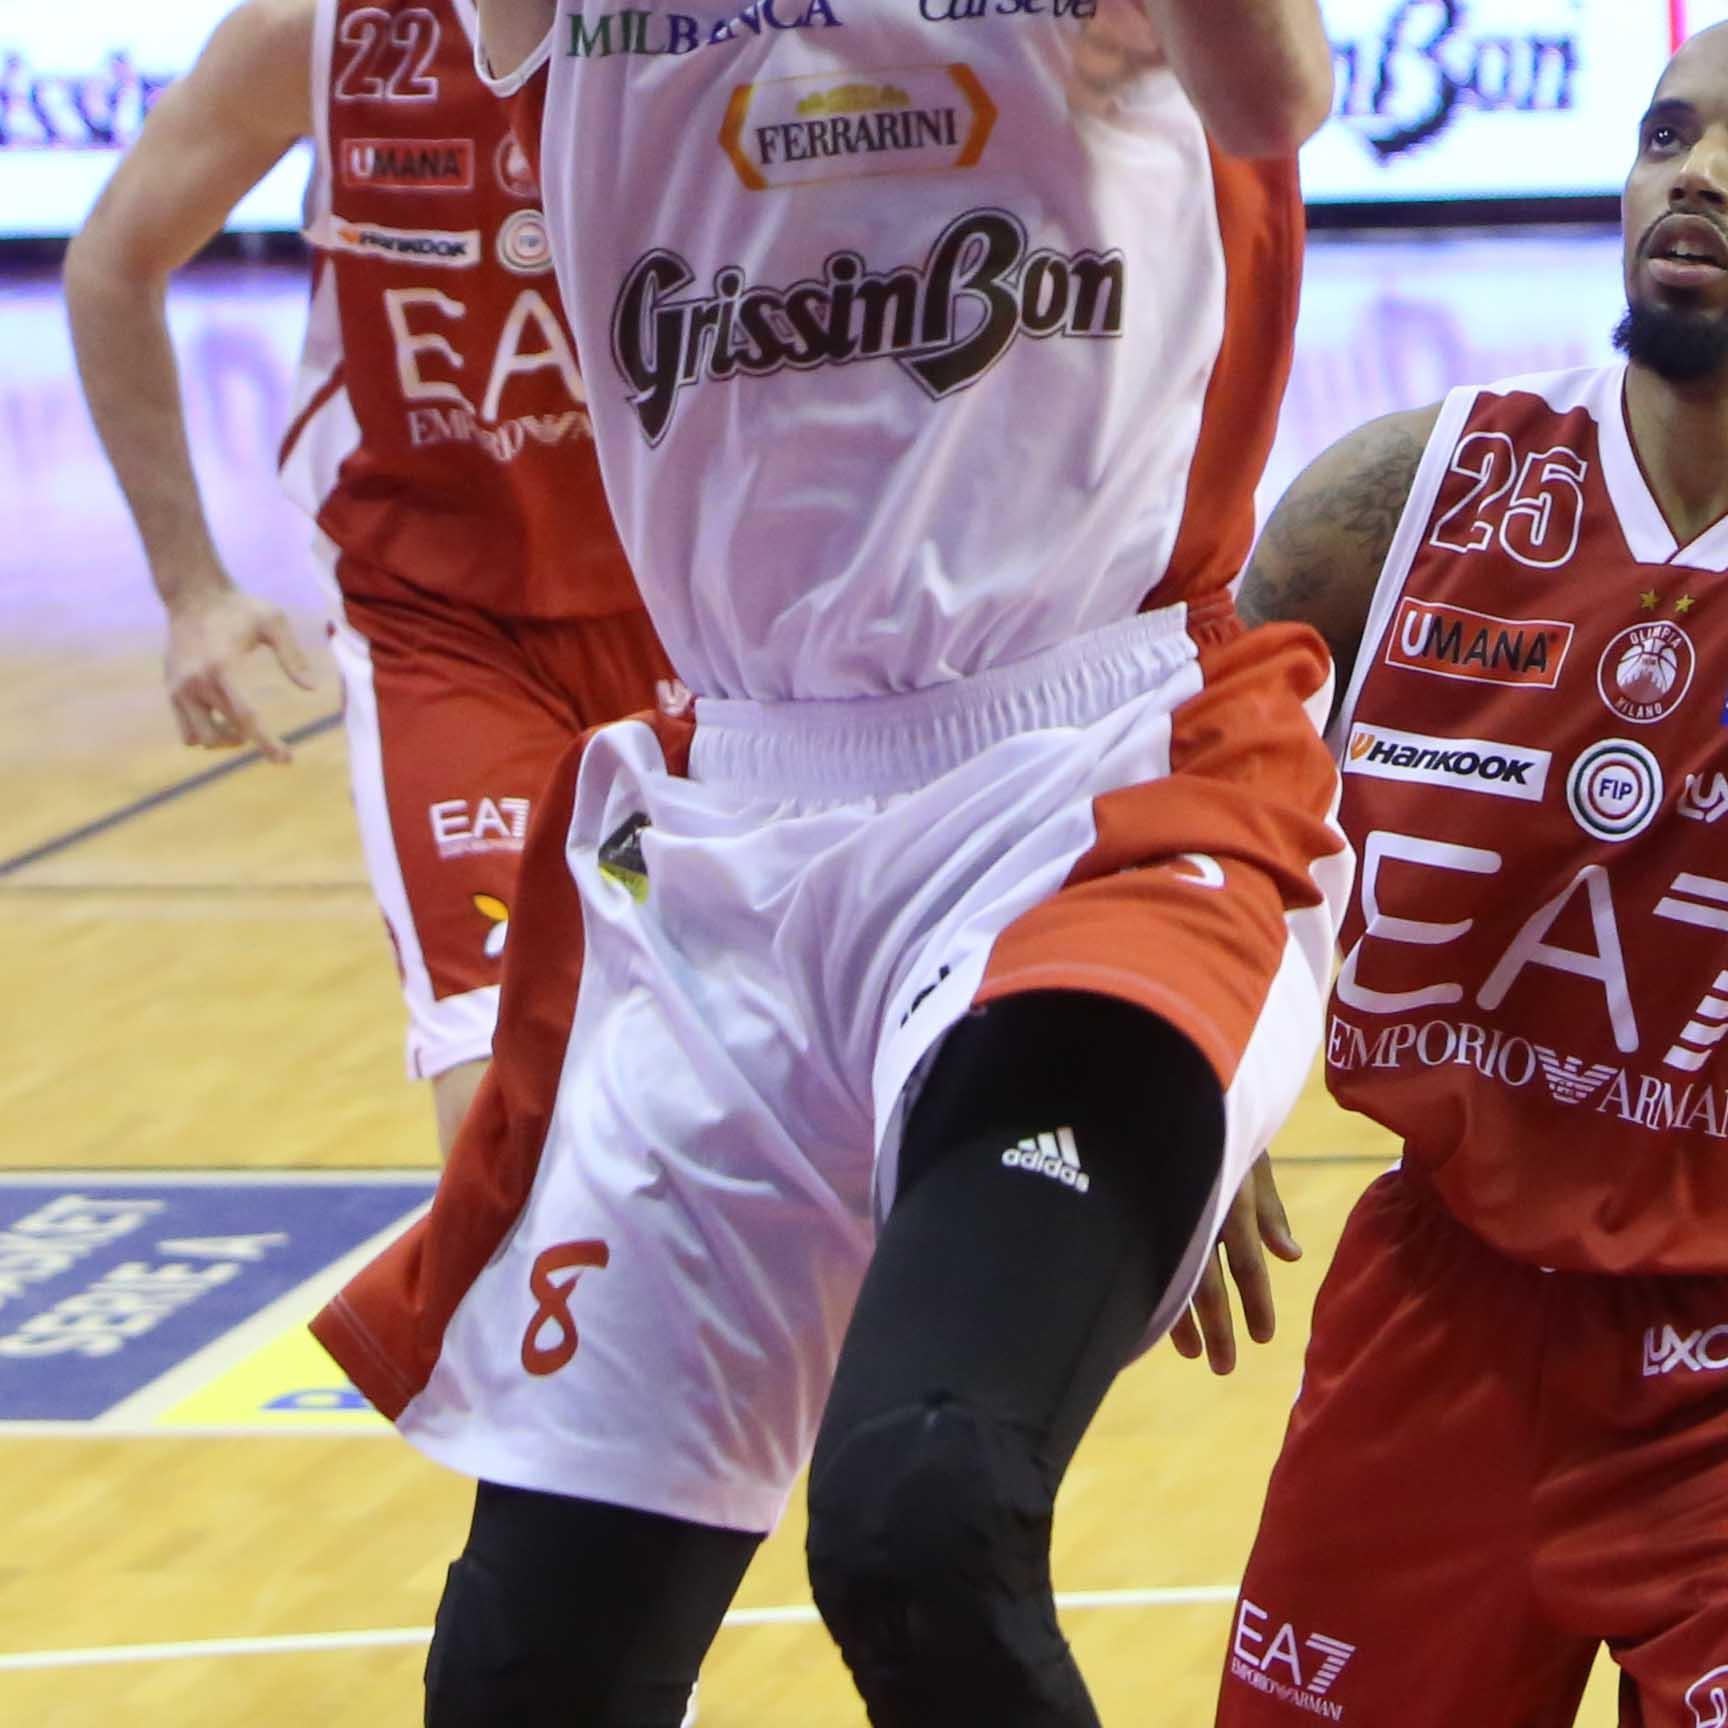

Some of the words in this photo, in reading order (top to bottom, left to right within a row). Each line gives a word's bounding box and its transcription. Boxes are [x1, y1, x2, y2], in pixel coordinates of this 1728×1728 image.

[335, 7, 441, 103] 22
[350, 148, 461, 181] UMANA
[756, 107, 958, 165] FERRARINI
[612, 206, 1126, 448] GrissinBon
[1429, 431, 1588, 569] 25
[1400, 610, 1549, 674] UMANA
[429, 796, 531, 843] EA7
[1599, 777, 1633, 801] FIP
[1326, 1014, 1537, 1088] EMPORIO
[1001, 1148, 1090, 1193] adidas
[154, 1230, 290, 1262] A
[520, 1238, 609, 1377] 8
[1233, 1598, 1357, 1695] EA7
[1290, 1688, 1344, 1722] ARMANI
